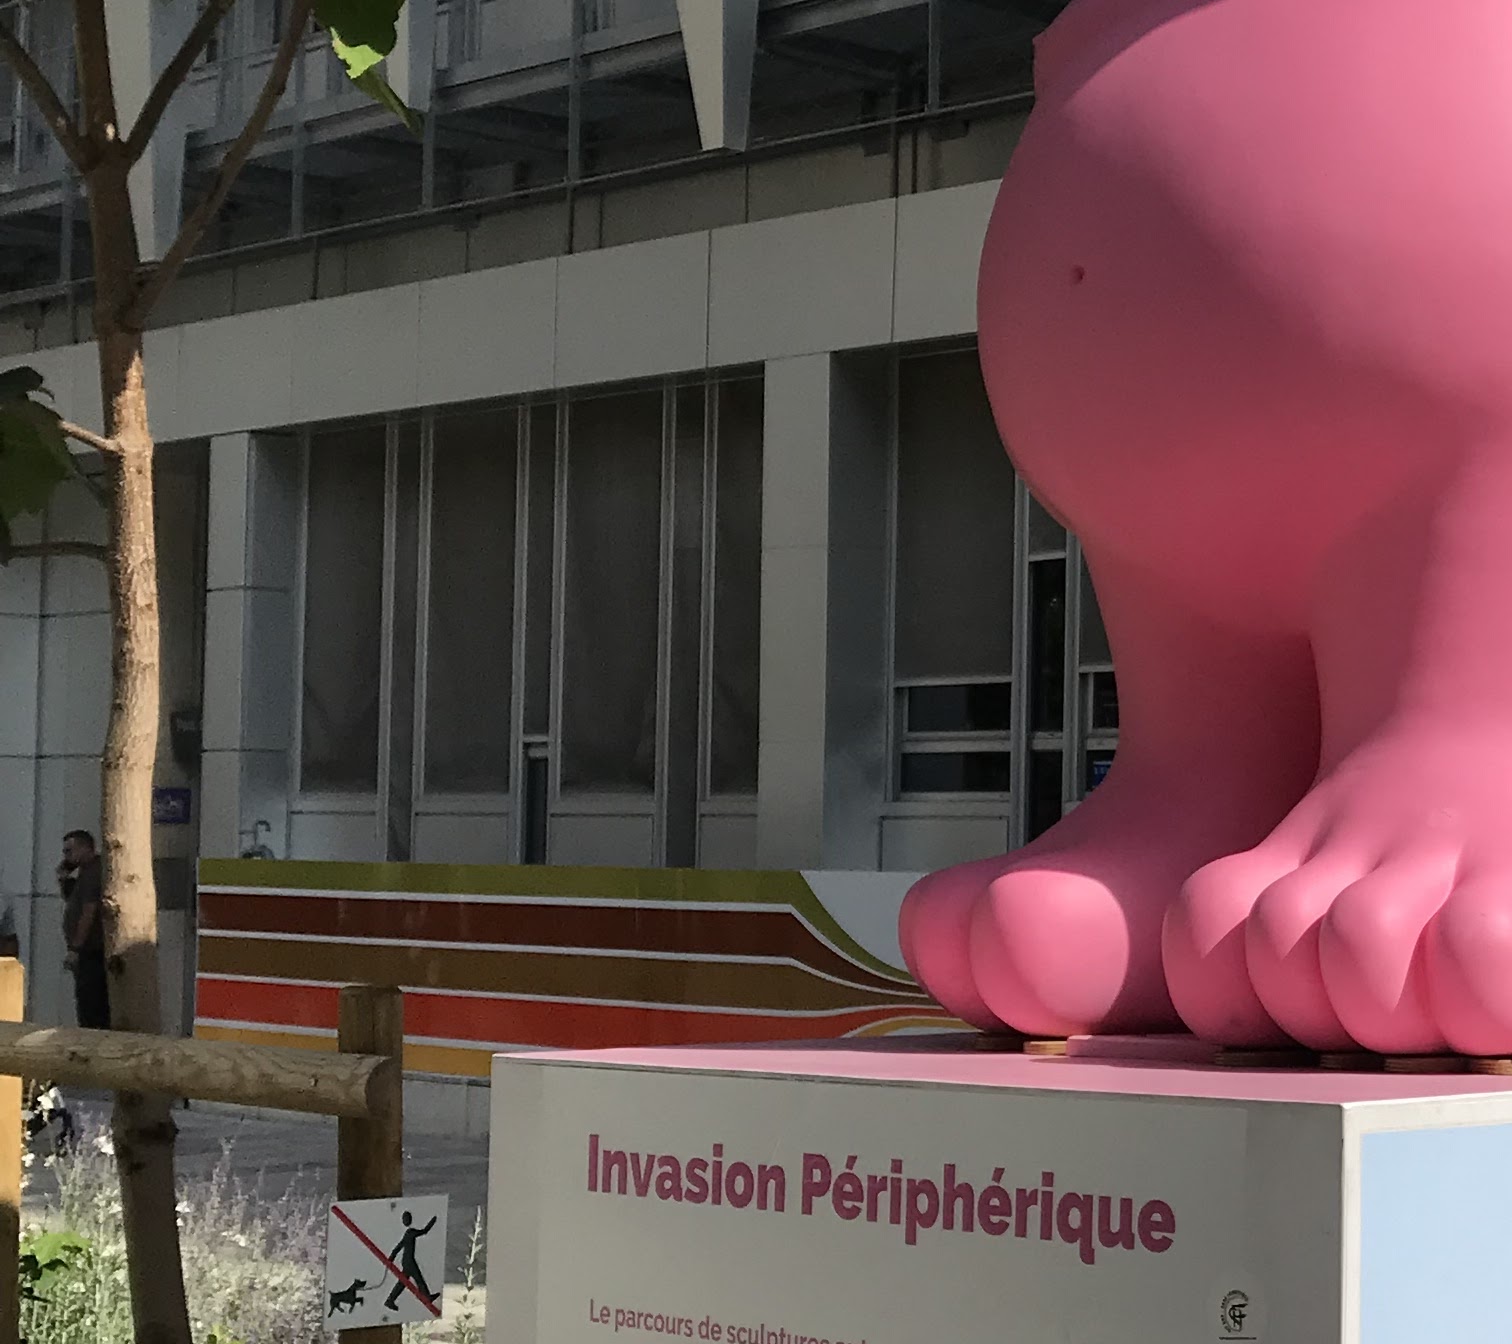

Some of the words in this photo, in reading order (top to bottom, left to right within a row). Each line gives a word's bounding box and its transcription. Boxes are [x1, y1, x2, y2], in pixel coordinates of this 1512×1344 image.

[587, 1133, 786, 1213] Invasion
[801, 1152, 1176, 1266] Périphérique
[589, 1298, 611, 1325] Le
[614, 1307, 694, 1338] parcours
[698, 1315, 722, 1342] de
